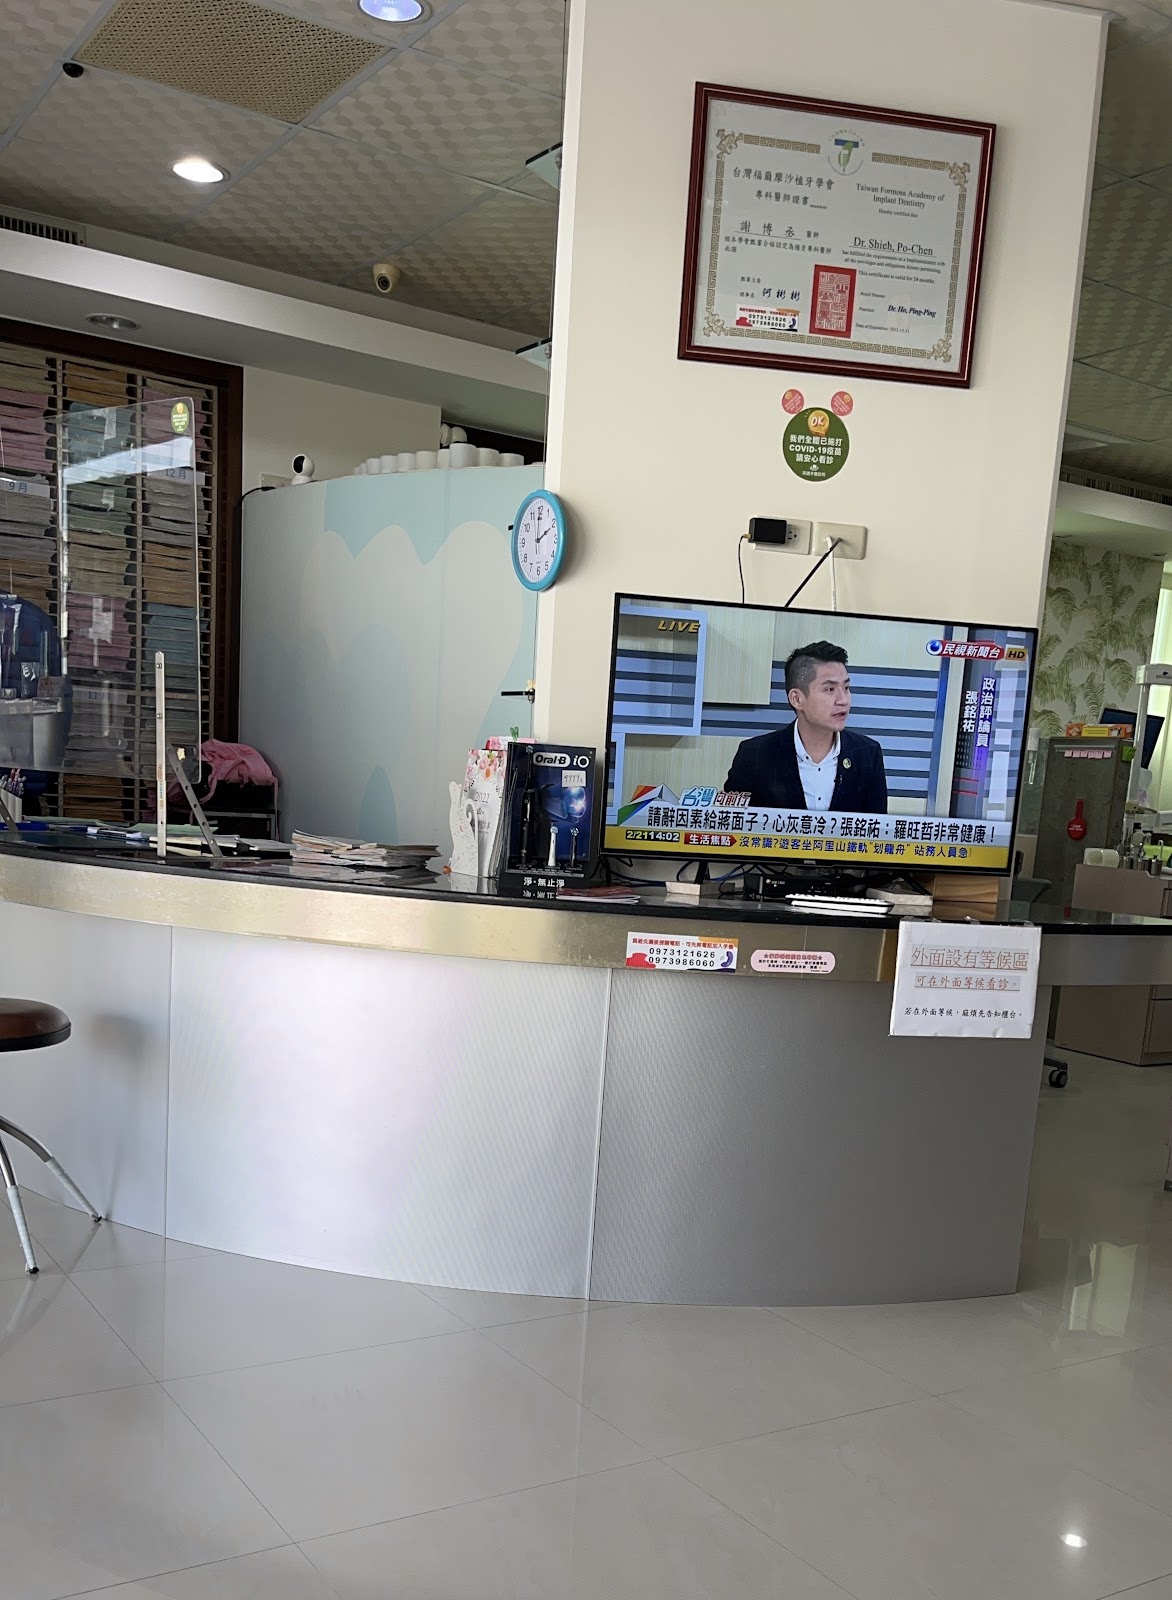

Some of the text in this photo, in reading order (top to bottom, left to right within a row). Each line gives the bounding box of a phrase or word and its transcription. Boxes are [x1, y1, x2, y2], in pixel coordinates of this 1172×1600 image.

[733, 166, 834, 191] 台灣福爾摩沙植牙學會
[755, 189, 810, 206] 專科醫師證書
[856, 183, 946, 202] Taiwan Formosa Academy of
[873, 194, 926, 209] Implant Dentistry
[853, 237, 933, 256] Dr. Shieh, Po-Chen
[908, 307, 937, 318] Ping-Ping
[811, 415, 825, 427] OK
[790, 434, 843, 447] 我們全體已施打
[789, 444, 842, 456] COVID-19疫苗
[796, 453, 834, 465] 請安心看診
[657, 620, 700, 633] LIVE
[943, 643, 1025, 659] 民視新聞台 HD
[962, 690, 978, 733] 張銘祐
[976, 677, 996, 747] 政治評論員
[535, 754, 567, 765] Oral-B
[681, 786, 752, 809] 台灣向前行
[688, 833, 731, 847] 生活焦點
[649, 947, 716, 959] 0973121626
[910, 946, 1029, 969] 外面設有等候區
[648, 956, 715, 968] 0973986060
[916, 975, 1017, 991] 可在外面等候看診。
